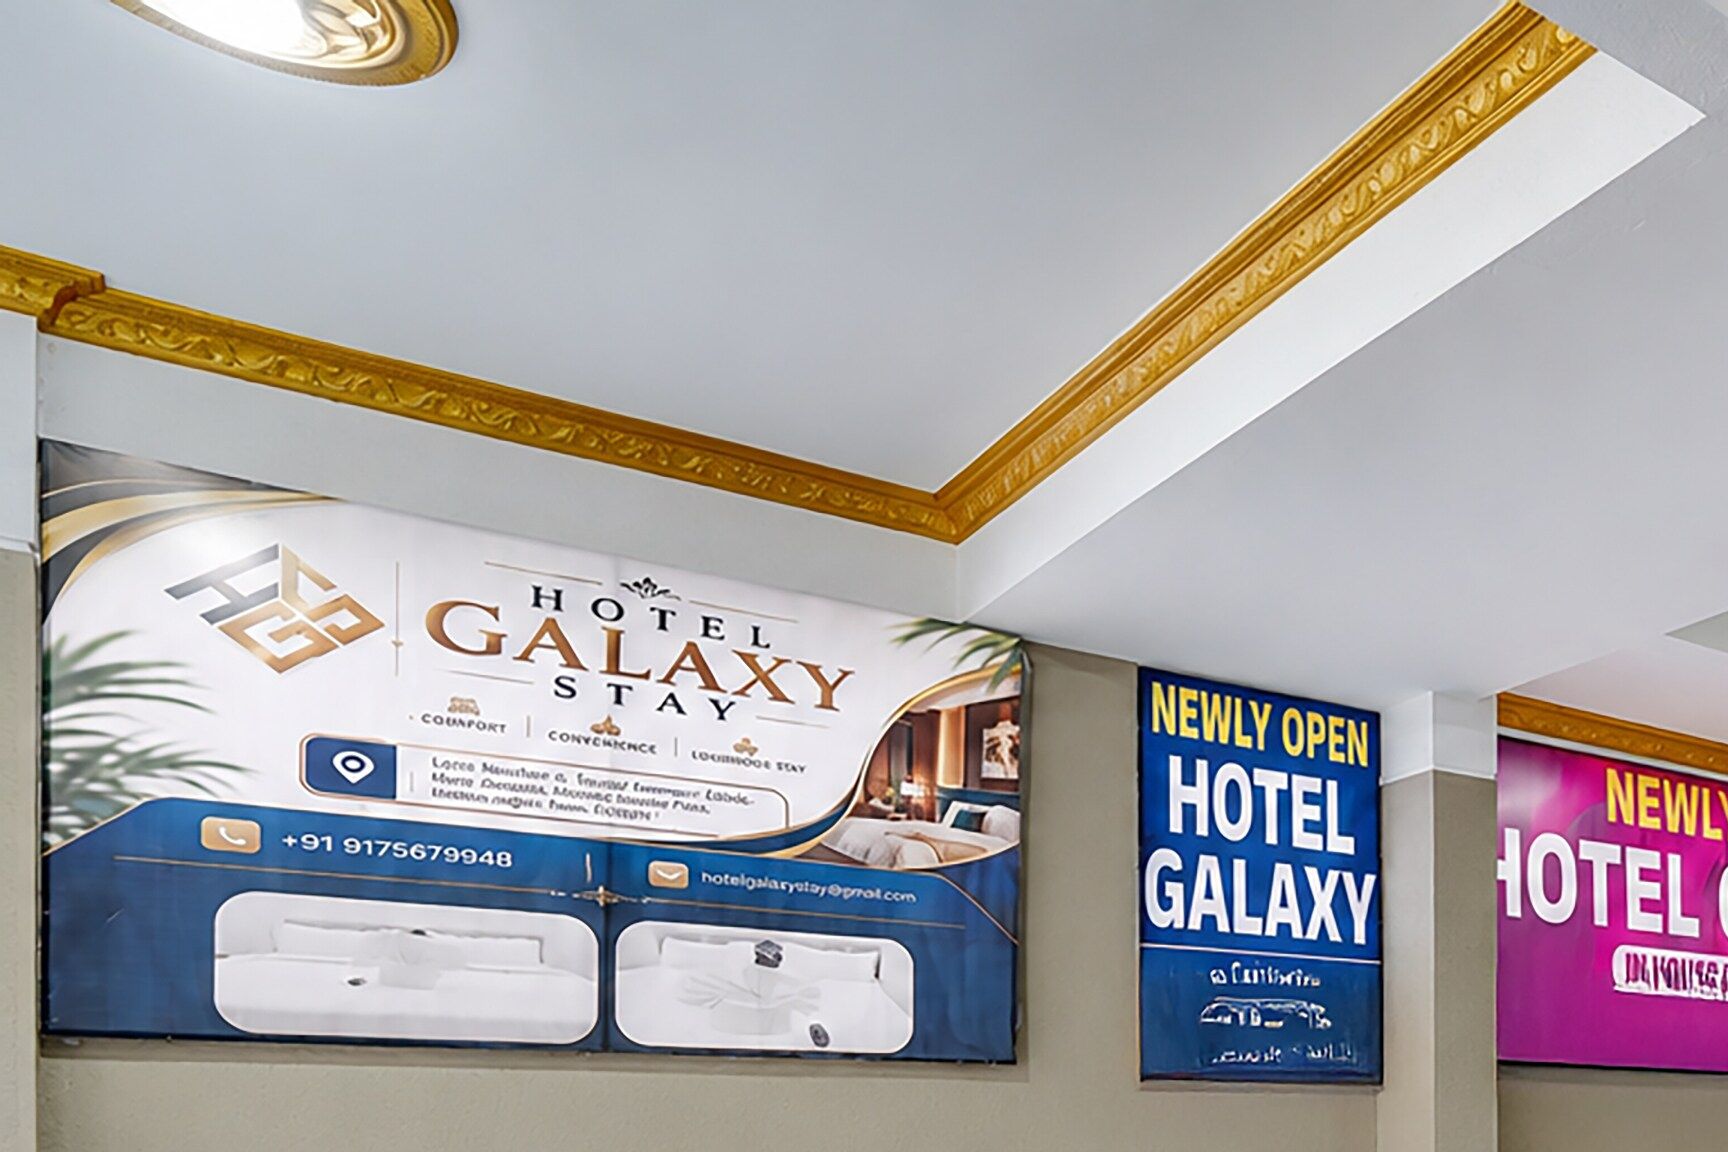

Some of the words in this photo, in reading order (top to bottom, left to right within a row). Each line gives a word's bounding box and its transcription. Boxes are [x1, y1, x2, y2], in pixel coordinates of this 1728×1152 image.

[425, 599, 855, 712] GALAXY
[532, 585, 770, 649] HOTEL
[553, 675, 738, 722] STAY
[1151, 681, 1274, 751] NEWLY
[1282, 707, 1369, 768] OPEN
[1168, 755, 1355, 855] HOTEL
[282, 833, 334, 852] +91
[343, 838, 513, 868] 9175679948
[1144, 848, 1377, 945] GALAXY
